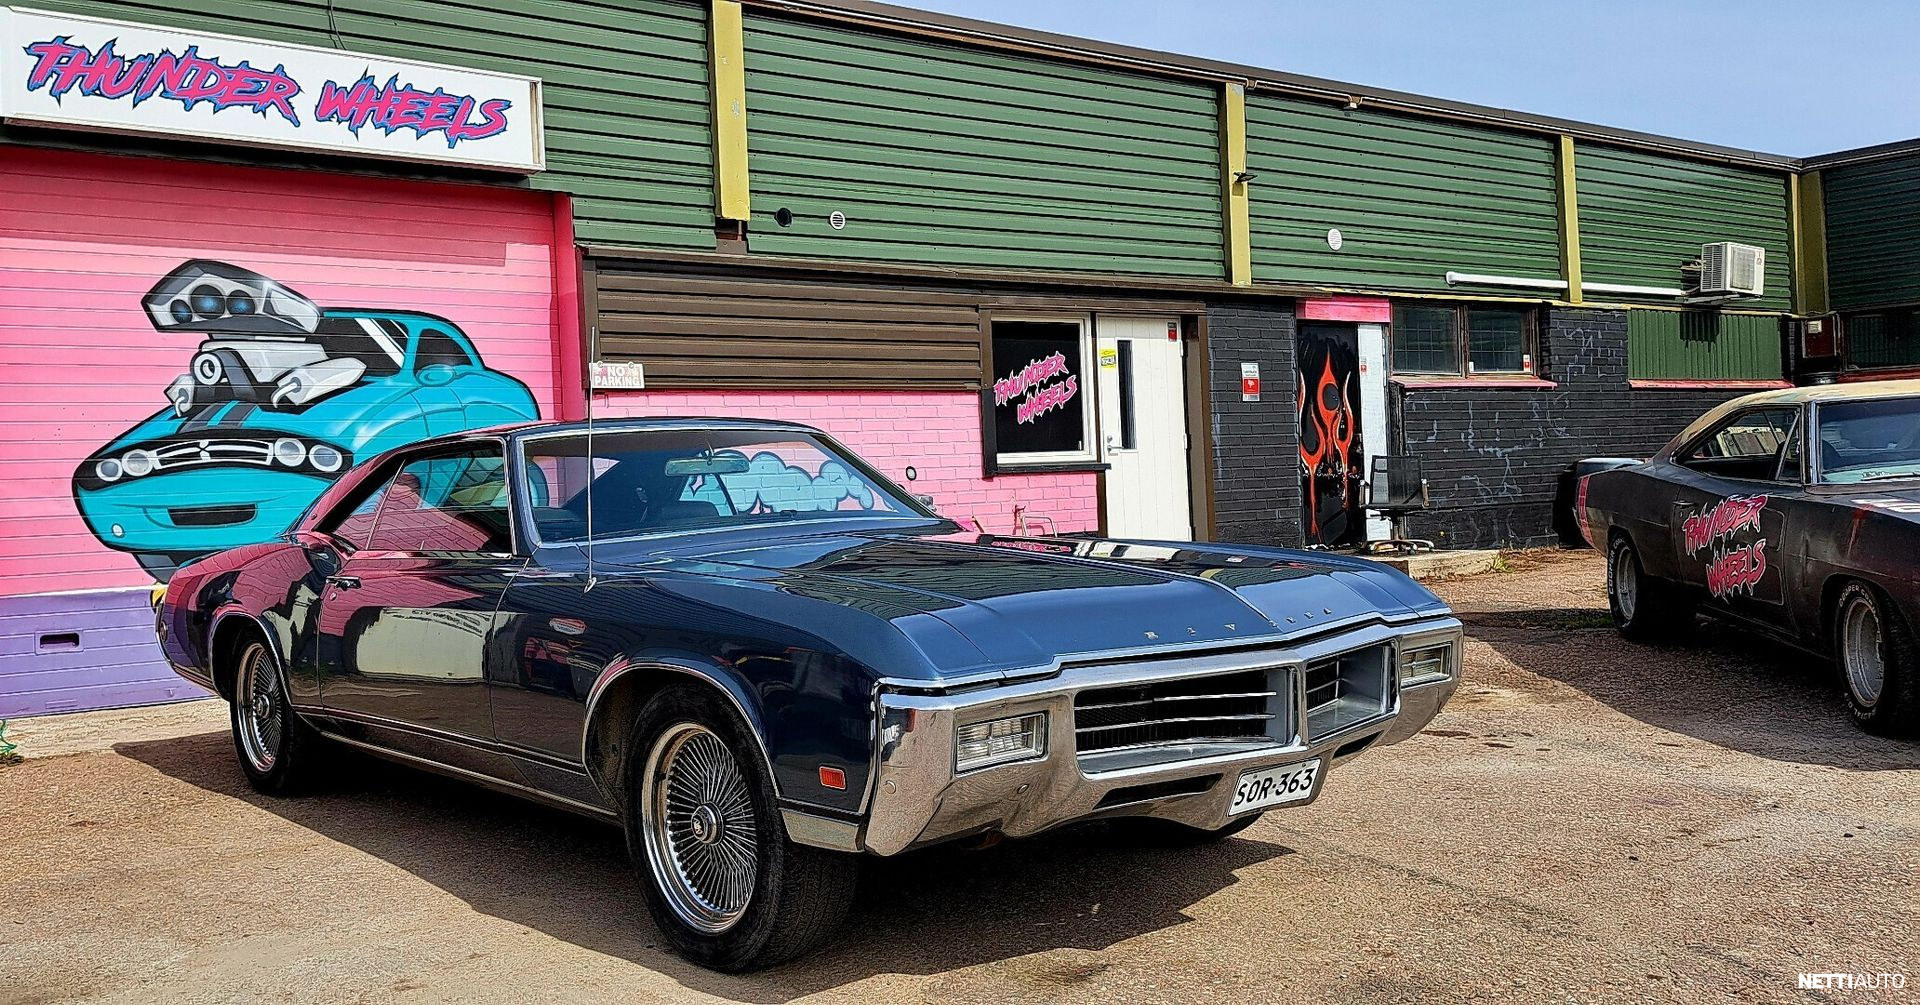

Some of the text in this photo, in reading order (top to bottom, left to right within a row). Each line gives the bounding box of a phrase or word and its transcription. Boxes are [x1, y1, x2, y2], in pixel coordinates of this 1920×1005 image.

[23, 36, 512, 149] THUNDER WHEELS
[594, 375, 641, 387] PARKING
[608, 366, 625, 377] NO
[993, 351, 1069, 406] THUNDER
[1017, 375, 1077, 424] WHEELS
[1682, 494, 1767, 560] THUNDER
[1706, 538, 1766, 599] WHEELS
[1234, 767, 1316, 806] SOR-363
